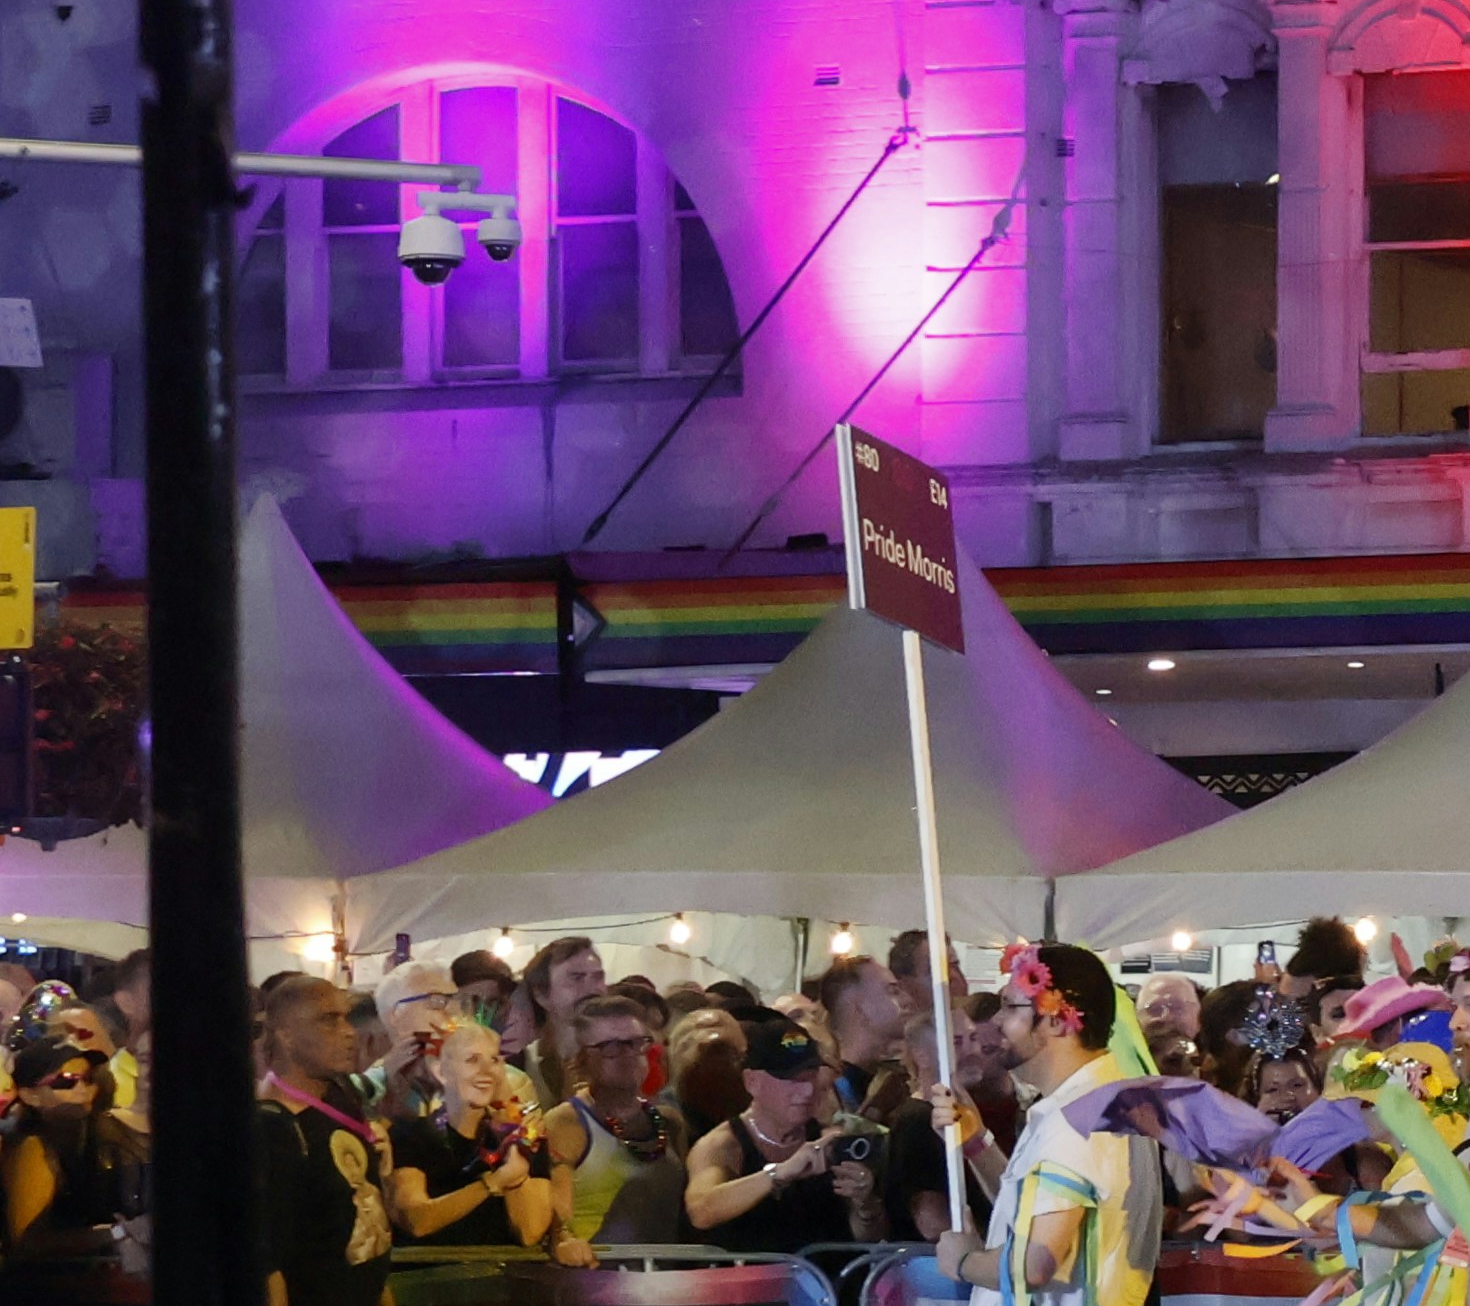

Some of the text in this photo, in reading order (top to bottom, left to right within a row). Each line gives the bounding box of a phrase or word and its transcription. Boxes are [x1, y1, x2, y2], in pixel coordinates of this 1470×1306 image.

[855, 441, 880, 473] #80
[929, 478, 949, 510] E14
[863, 518, 956, 594] Pride Morris
